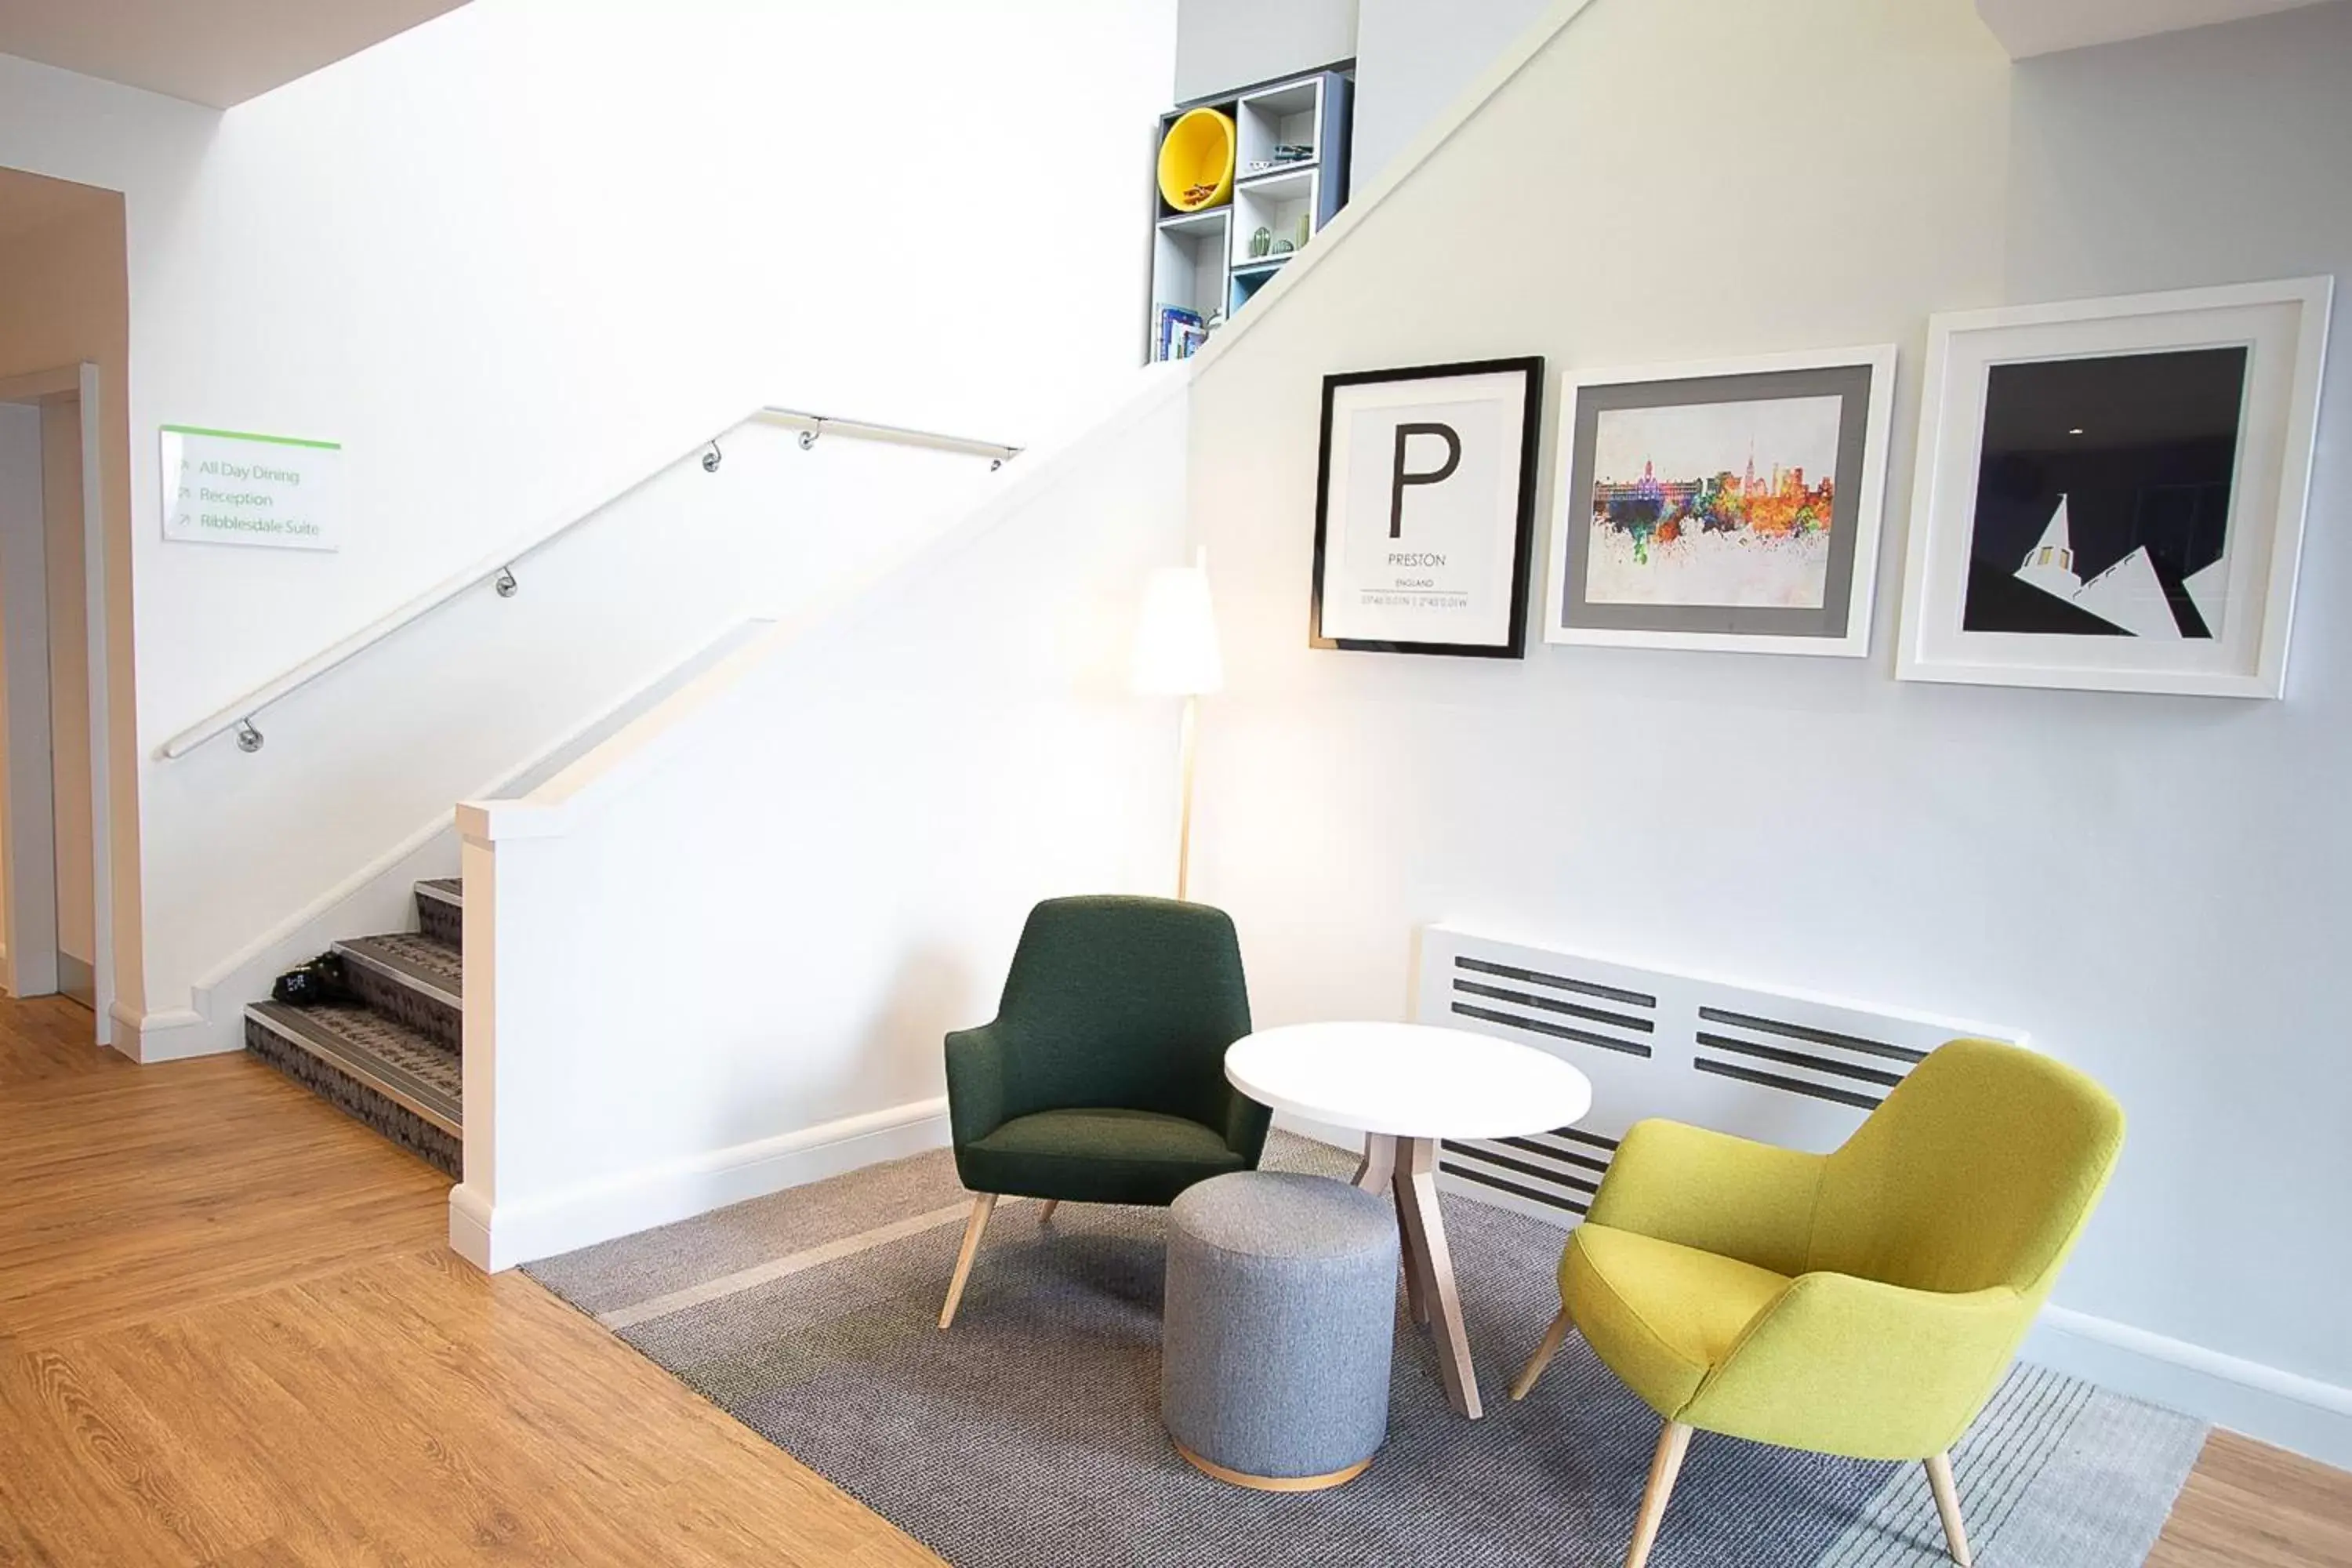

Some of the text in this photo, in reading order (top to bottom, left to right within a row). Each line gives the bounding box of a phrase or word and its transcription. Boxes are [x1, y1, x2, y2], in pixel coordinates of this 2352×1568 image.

[199, 461, 299, 485] All Day Dining
[1389, 423, 1461, 539] P
[200, 488, 273, 508] Reception
[201, 514, 320, 536] Ribblesdale Suite
[1388, 552, 1446, 567] PRESTON
[1395, 578, 1434, 588] ENGLAND
